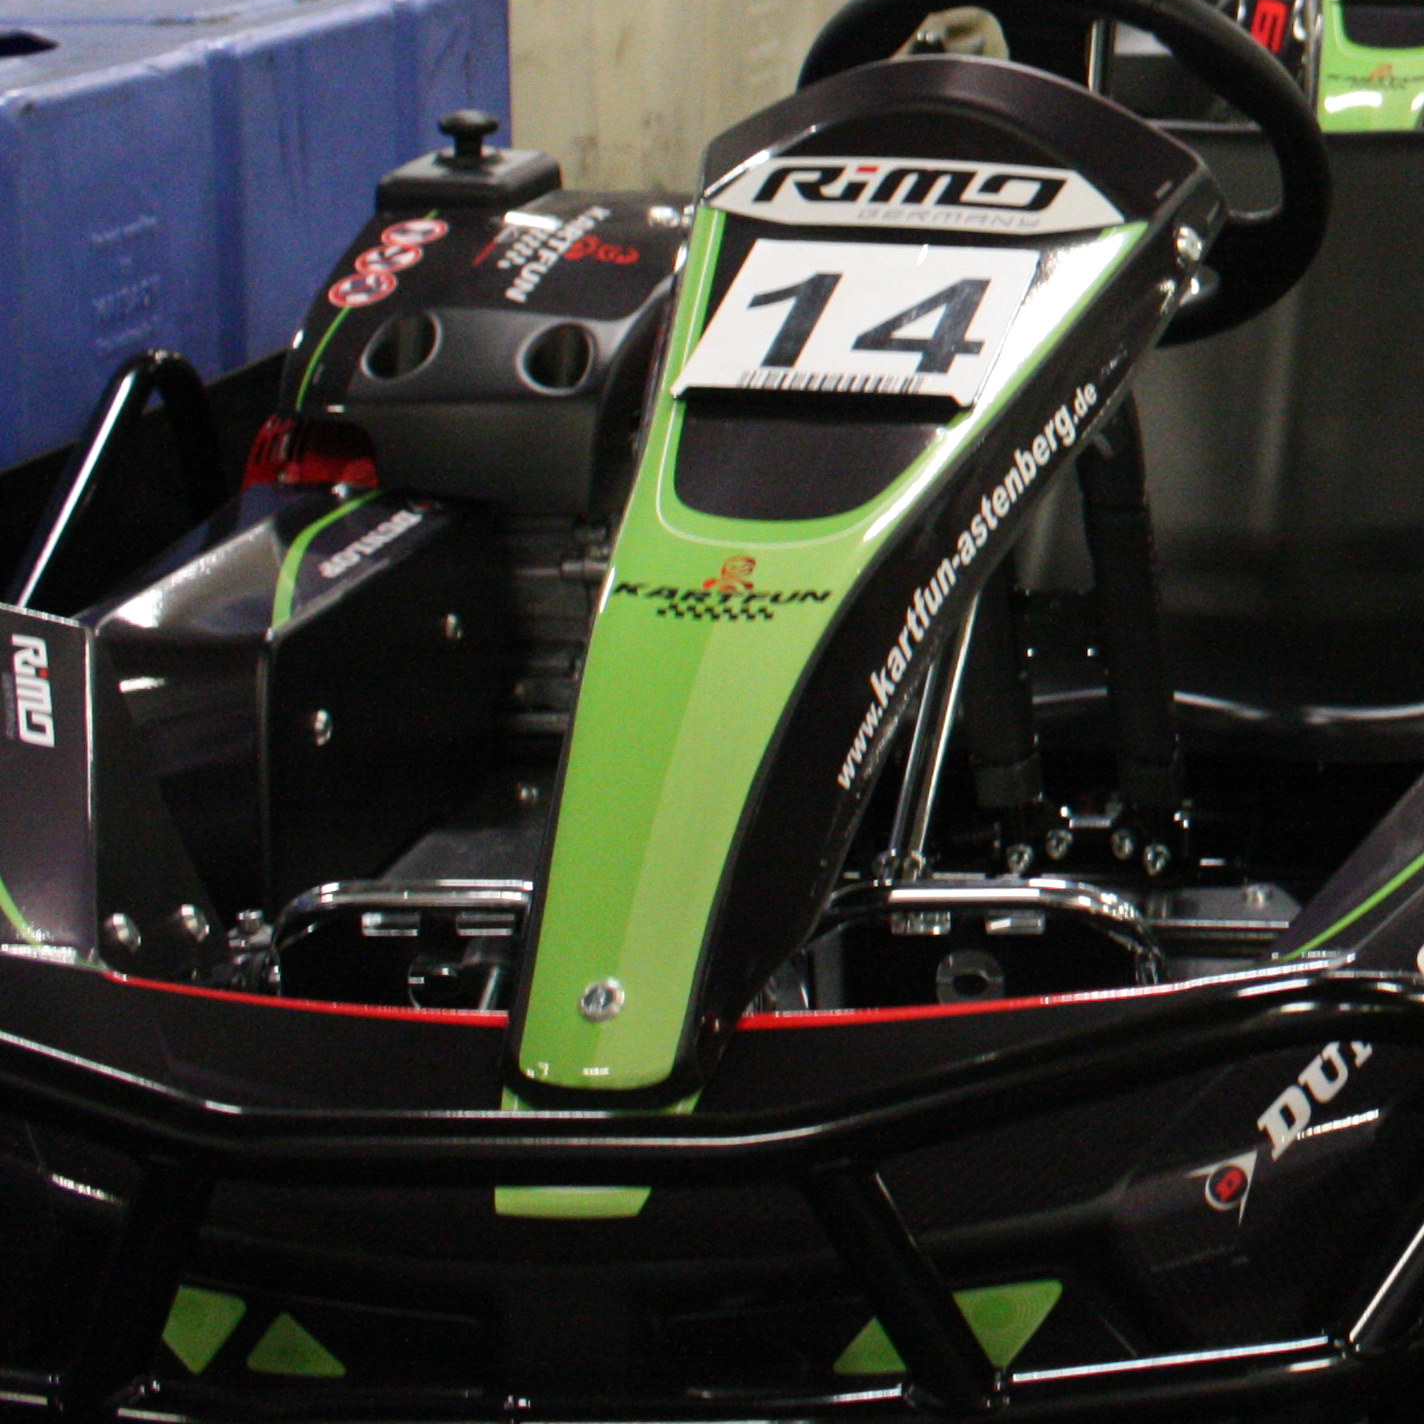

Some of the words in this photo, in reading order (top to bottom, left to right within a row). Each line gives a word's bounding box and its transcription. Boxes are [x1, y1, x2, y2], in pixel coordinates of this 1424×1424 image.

[856, 207, 1043, 231] GERMANY
[746, 271, 993, 375] 14
[612, 580, 833, 606] KARTFUN
[836, 382, 1099, 792] www.kartfun-astenberg.de
